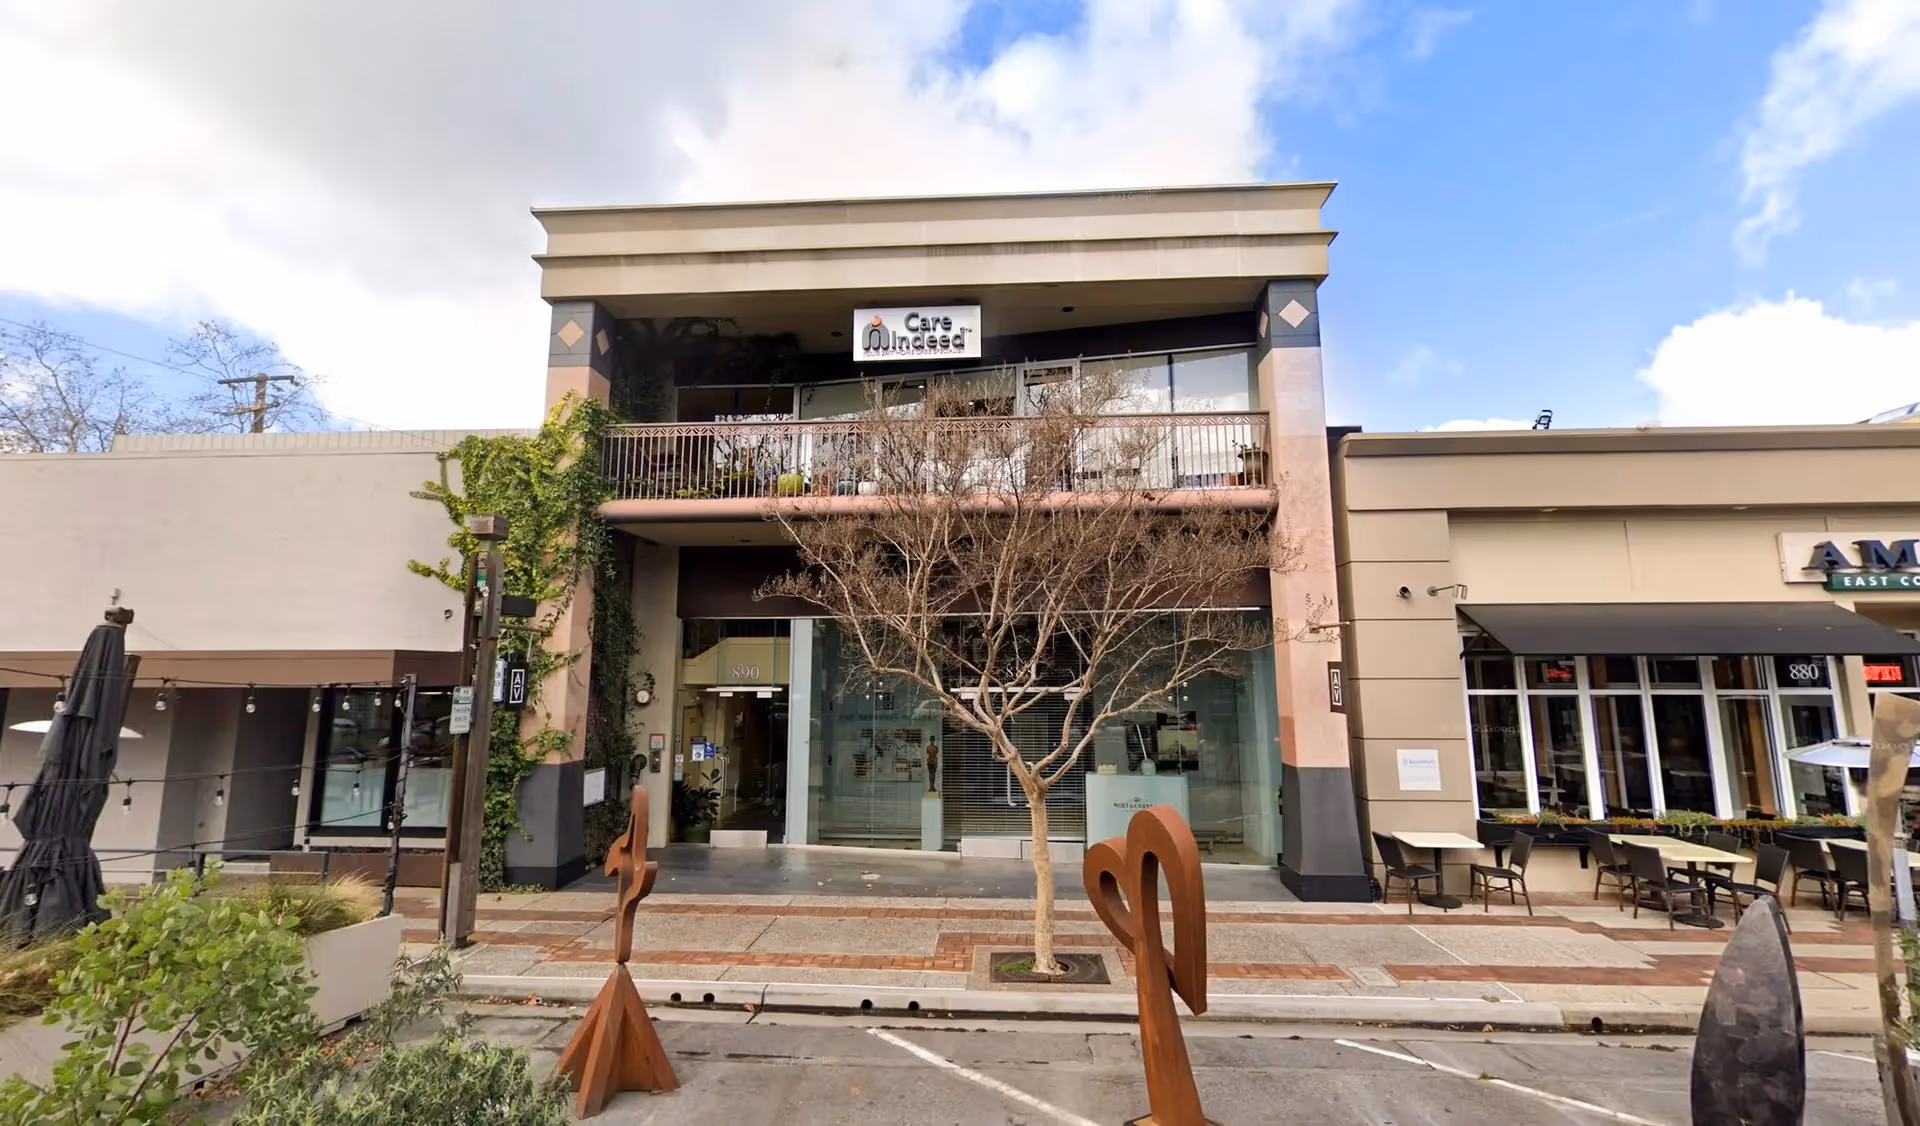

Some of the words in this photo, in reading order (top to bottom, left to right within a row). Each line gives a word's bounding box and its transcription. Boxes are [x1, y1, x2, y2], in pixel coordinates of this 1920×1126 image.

[904, 312, 952, 332] Care
[1844, 576, 1889, 586] EAST
[731, 665, 760, 680] 890
[1789, 663, 1818, 680] 880
